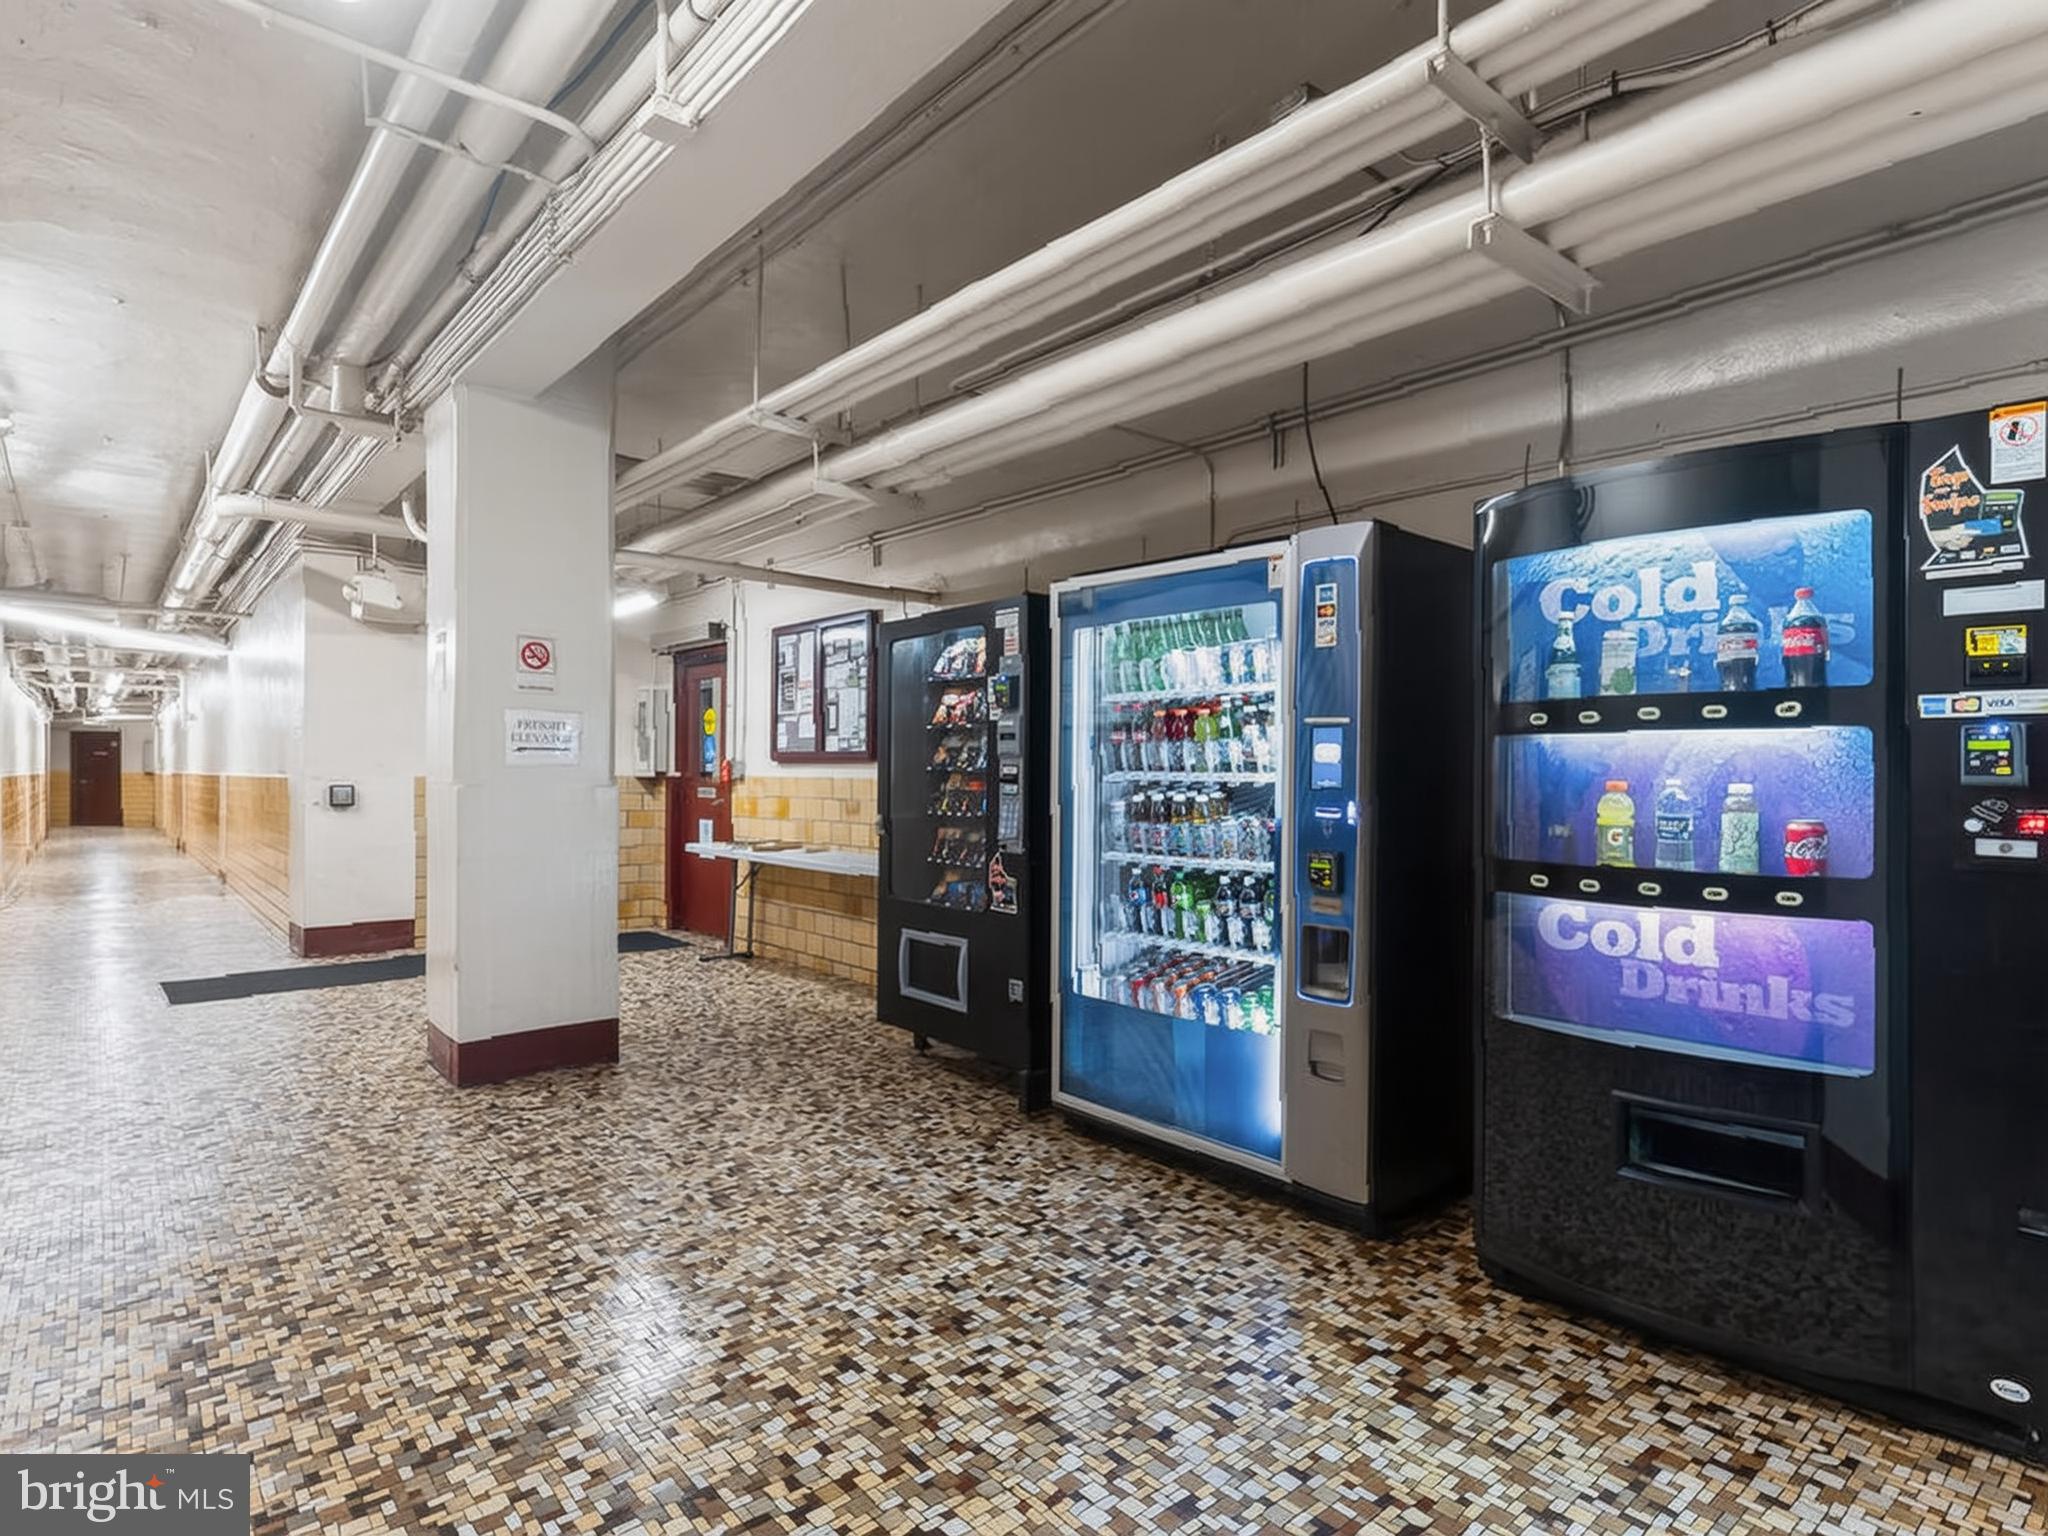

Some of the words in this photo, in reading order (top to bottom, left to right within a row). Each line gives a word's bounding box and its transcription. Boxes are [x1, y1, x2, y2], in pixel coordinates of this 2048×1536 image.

[1539, 561, 1720, 625] Cold
[1537, 903, 1720, 968] Cold
[1619, 959, 1855, 1027] Drinks
